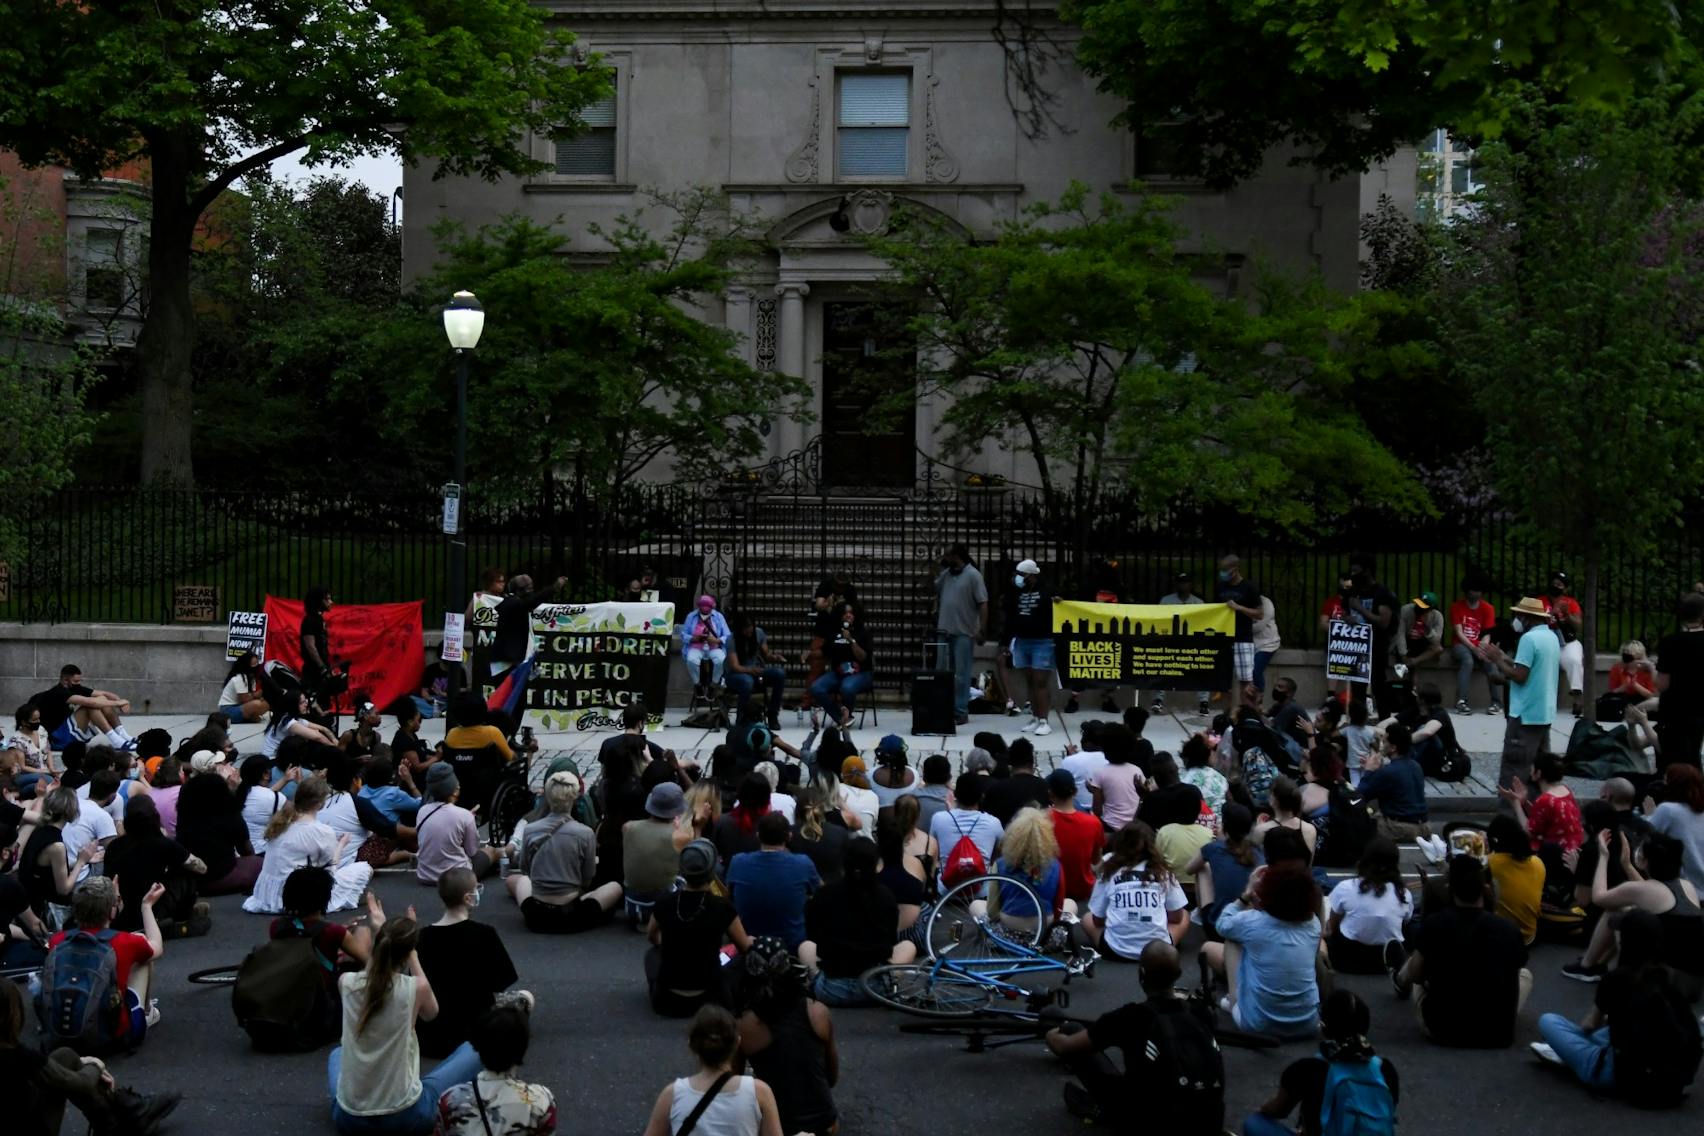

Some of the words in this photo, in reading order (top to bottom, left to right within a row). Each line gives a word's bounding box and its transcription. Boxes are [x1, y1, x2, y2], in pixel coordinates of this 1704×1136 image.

[176, 606, 213, 618] JANET?
[231, 611, 266, 625] FREE
[230, 626, 262, 636] MUMIA
[1331, 622, 1369, 639] FREE
[229, 640, 253, 649] NOW!
[552, 634, 669, 656] CHILDREN
[1069, 640, 1114, 652] BLACK
[1330, 640, 1368, 653] MUMIA
[1072, 655, 1112, 665] LIVES
[1329, 653, 1358, 665] NOW!
[600, 661, 631, 681] TO
[1163, 662, 1190, 670] nothing
[1069, 667, 1121, 680] MATTER
[543, 688, 569, 706] IN
[575, 687, 644, 707] PEACE
[1115, 891, 1158, 908] PILOTS
